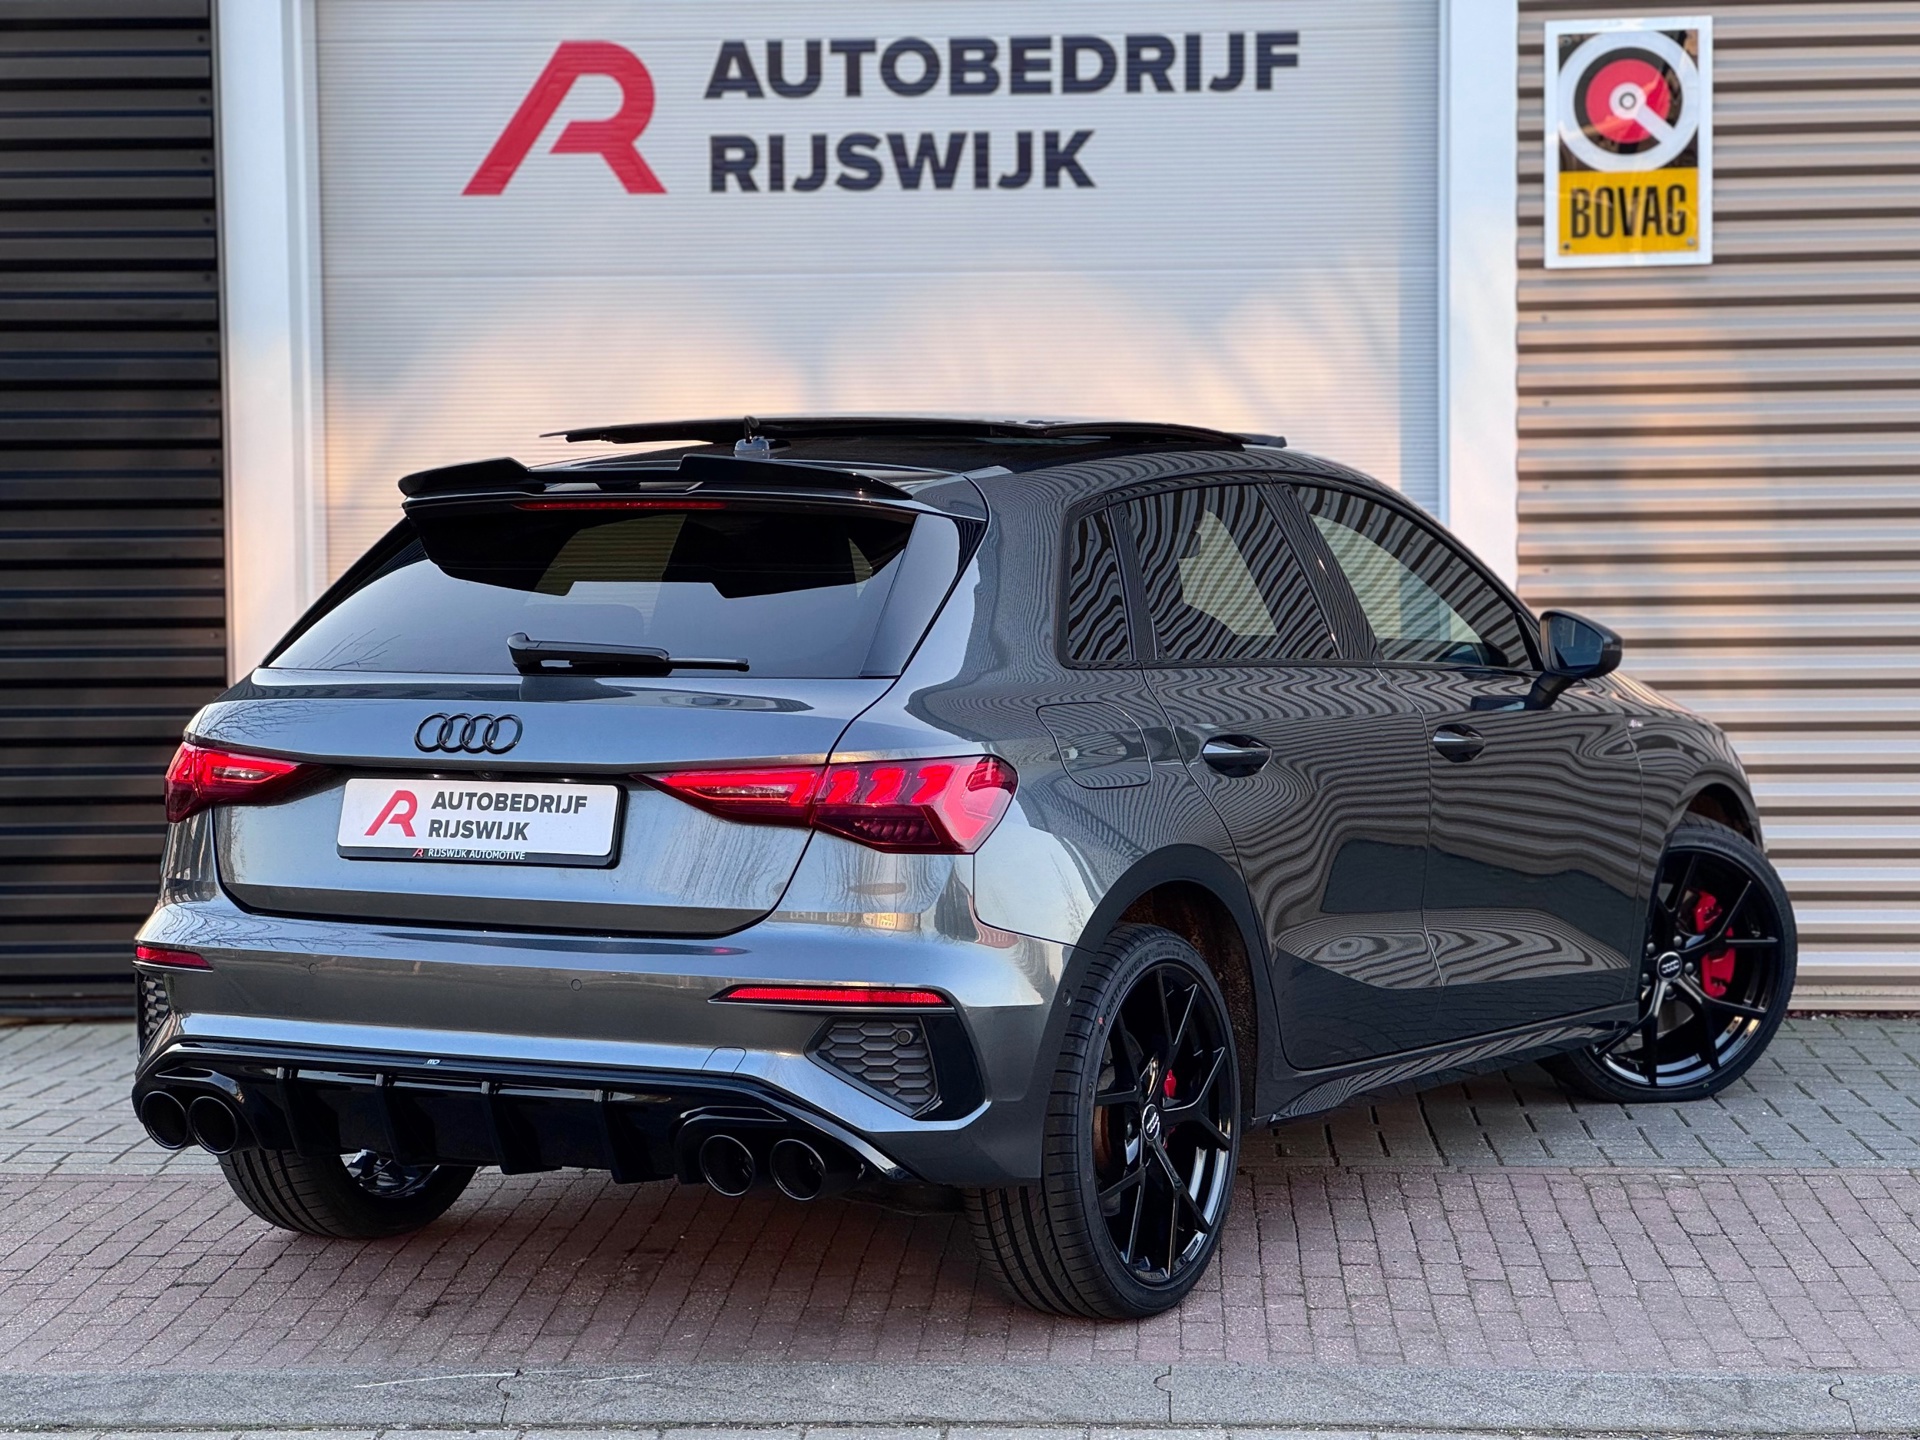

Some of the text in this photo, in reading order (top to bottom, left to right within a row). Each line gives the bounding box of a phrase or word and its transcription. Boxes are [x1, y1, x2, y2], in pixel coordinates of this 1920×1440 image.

[704, 32, 1299, 99] AUTOBEDRIJF
[709, 130, 1096, 194] RIJSWIJK
[1571, 184, 1687, 239] BOVAG
[431, 791, 588, 814] AUTOBEDRIJF
[428, 819, 529, 841] RIJSWIJK
[428, 848, 526, 860] RIJSWIJK AUTOMOTIVE
